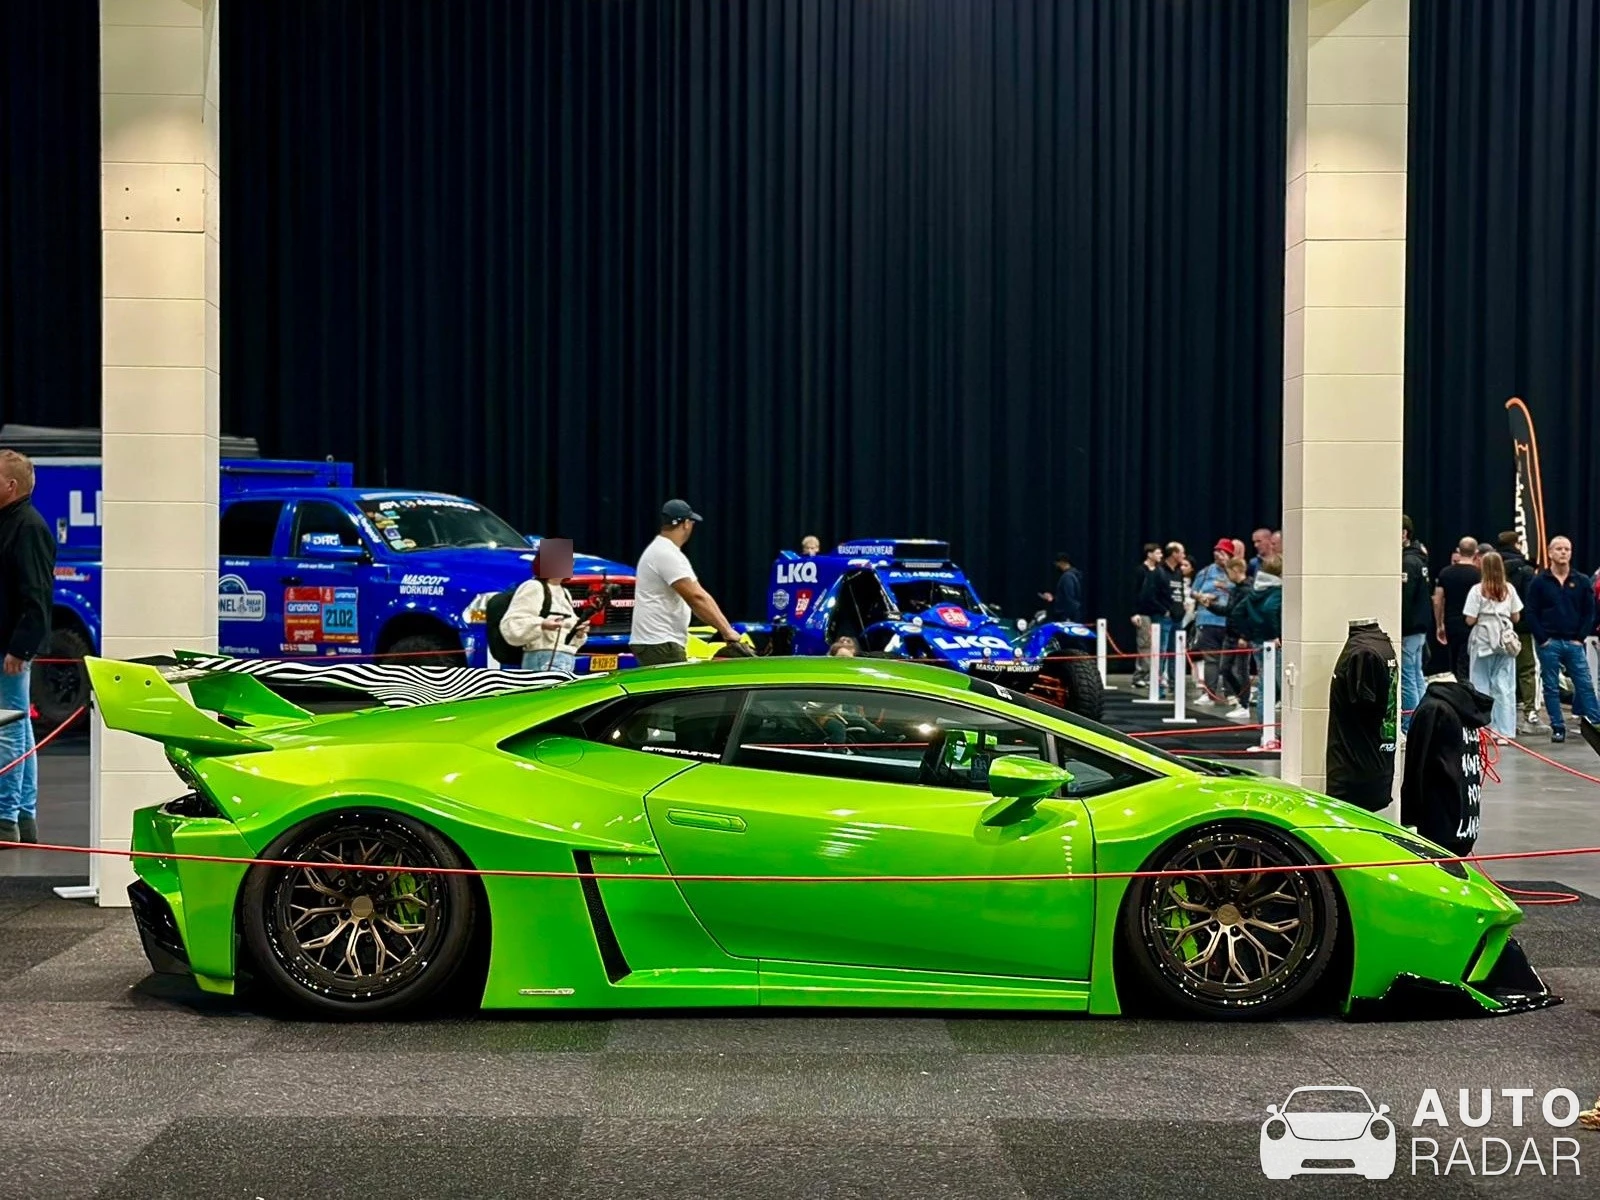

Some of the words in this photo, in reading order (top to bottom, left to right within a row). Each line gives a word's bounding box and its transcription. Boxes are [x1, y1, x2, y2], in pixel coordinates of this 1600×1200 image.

[776, 561, 818, 584] LKQ
[401, 574, 443, 585] MASCOT
[399, 585, 445, 596] WORKWEAR
[219, 598, 237, 612] NEL
[288, 603, 318, 612] aramco
[326, 609, 353, 627] 2102
[933, 635, 1014, 651] LKQ
[976, 663, 1003, 672] MASCOT
[1006, 664, 1041, 673] WORKWEAR
